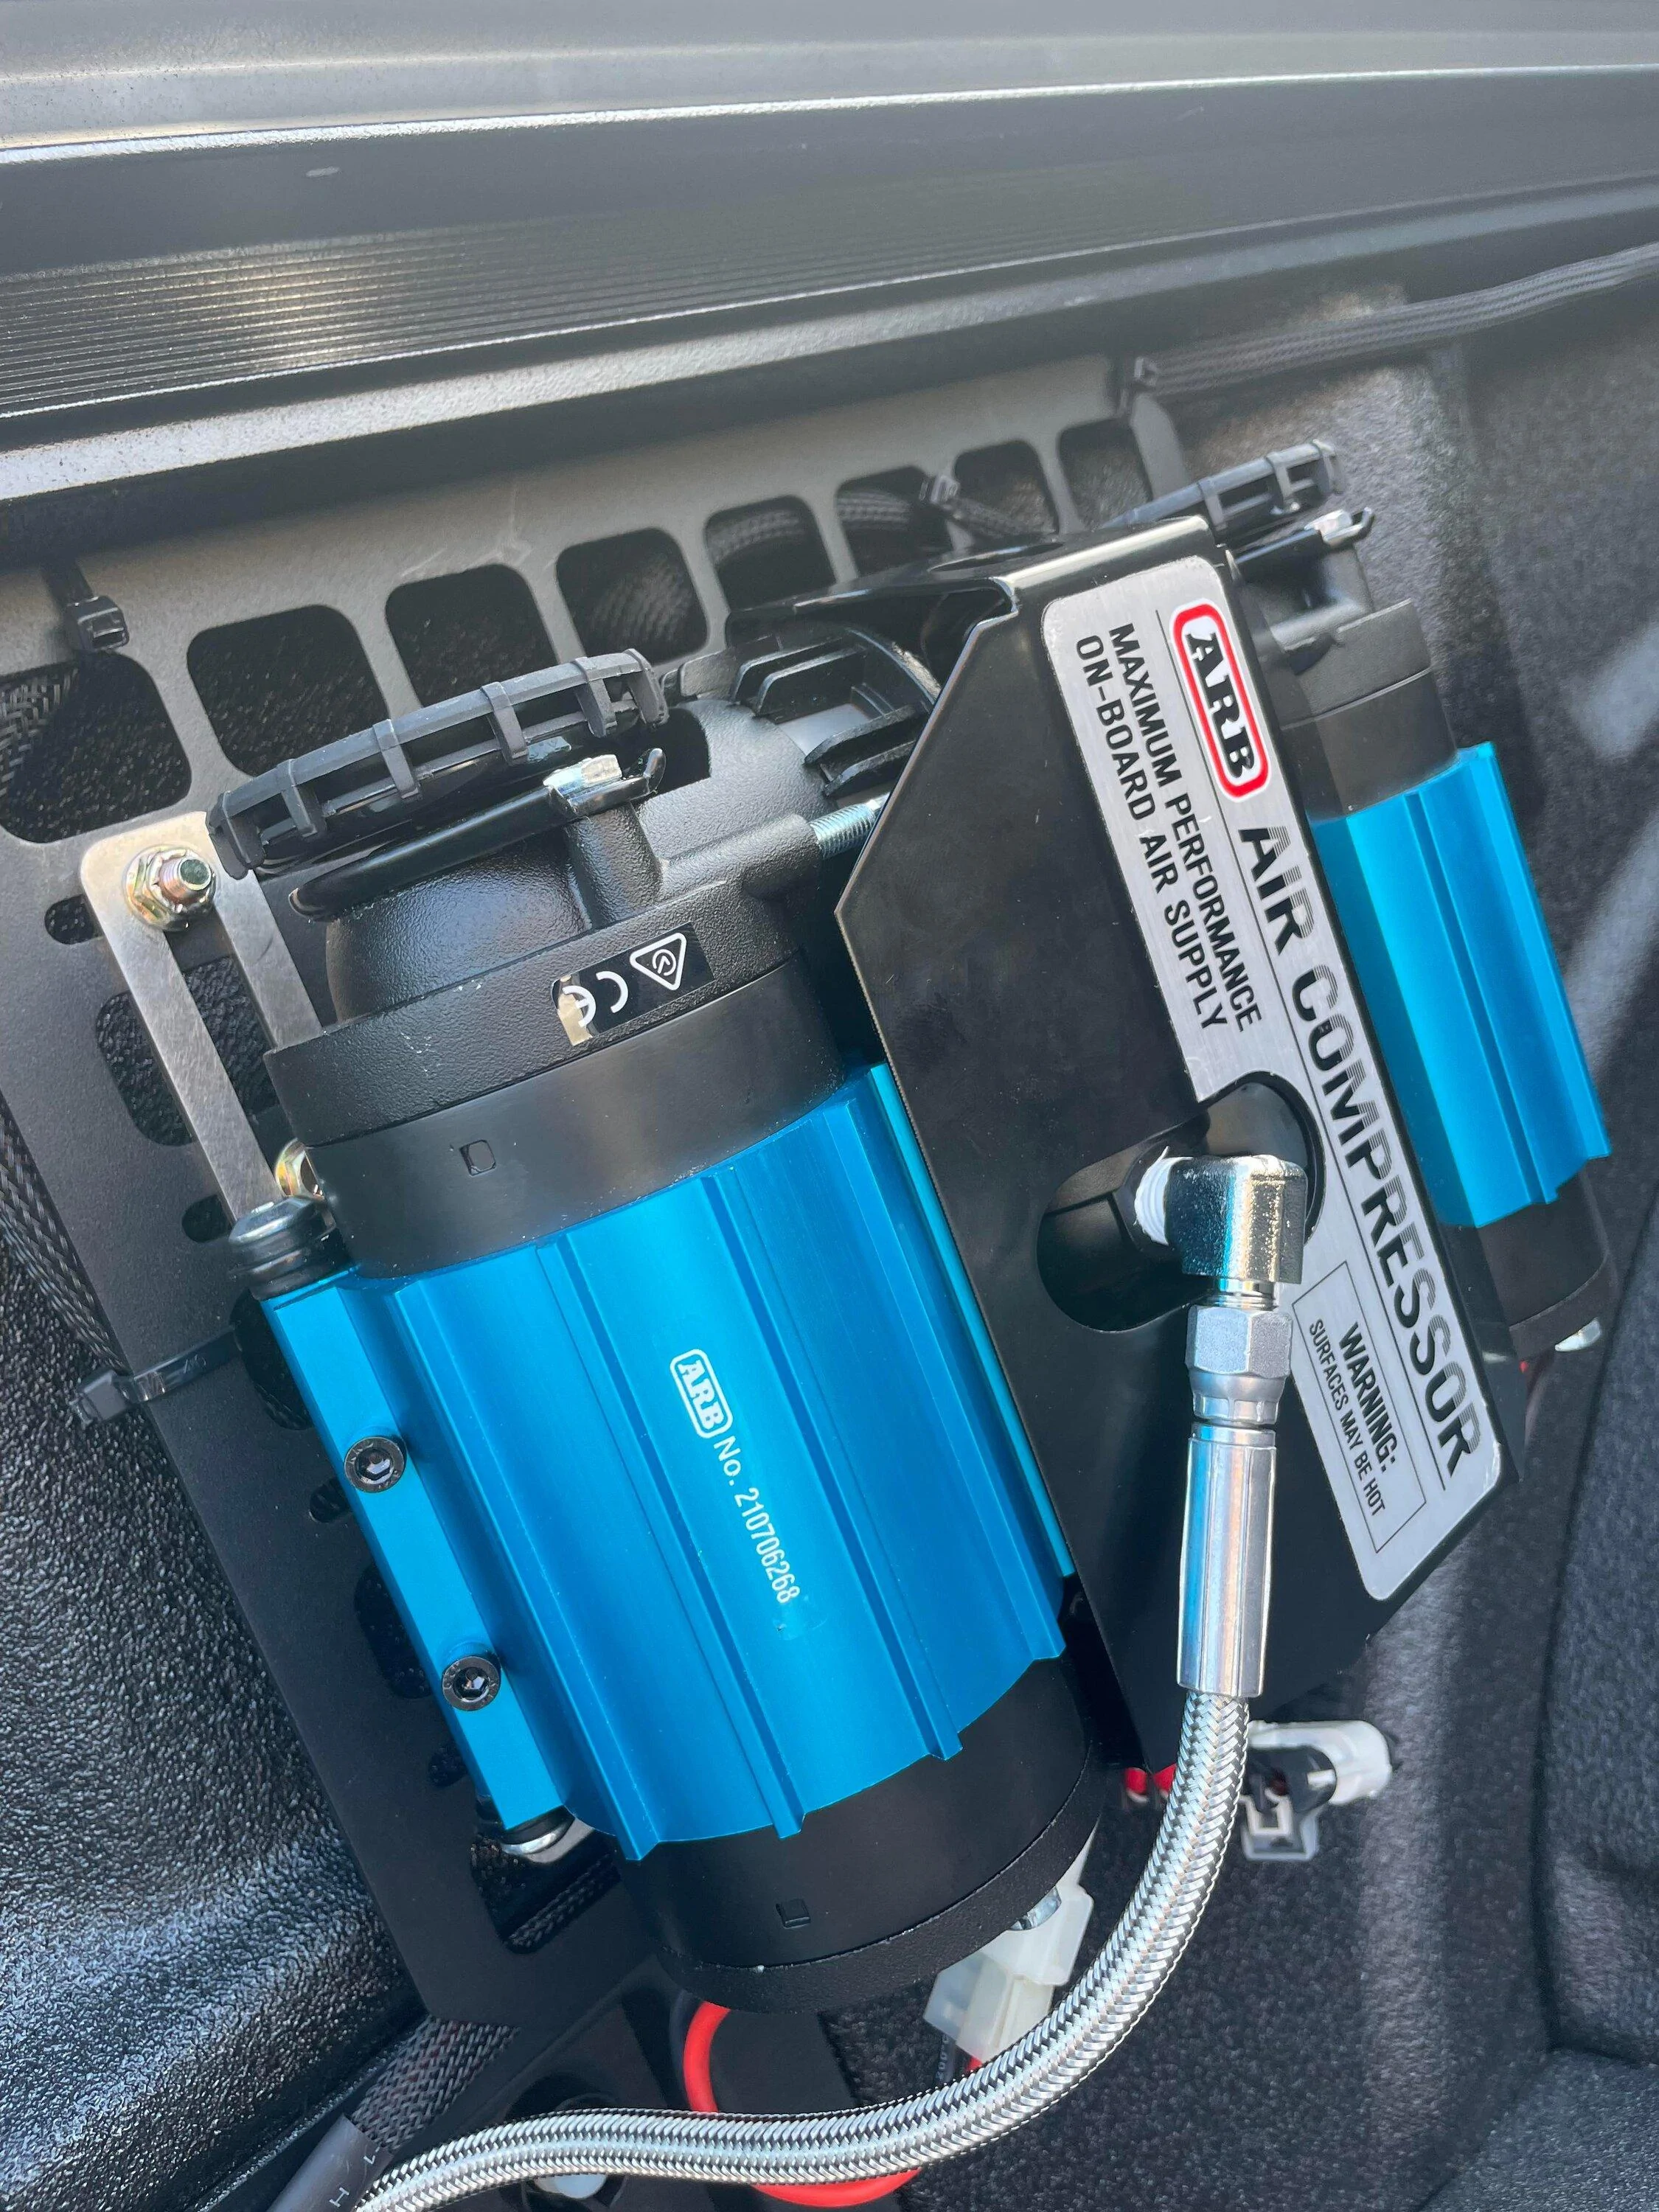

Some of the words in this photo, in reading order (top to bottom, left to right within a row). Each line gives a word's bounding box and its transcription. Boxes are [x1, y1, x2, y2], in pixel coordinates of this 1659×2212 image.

[1109, 623, 1183, 787] MAXIMUM
[1164, 793, 1262, 1032] PERFORMANCE
[1186, 632, 1255, 779] ARB
[1076, 636, 1155, 821] ON-BOARD
[1139, 834, 1178, 894] AIR
[1164, 900, 1227, 1029] SUPPLY
[1238, 826, 1315, 956] AIR
[1292, 964, 1481, 1478] COMPRESSOR
[678, 1360, 725, 1430] ARB
[714, 1436, 741, 1486] No.
[735, 1486, 801, 1604] 210706268
[1309, 1320, 1349, 1410] SURFACES
[1340, 1409, 1364, 1451] MAY
[1354, 1450, 1371, 1481] BE
[1363, 1481, 1385, 1515] HOT
[1340, 1321, 1397, 1473] WARNING:
